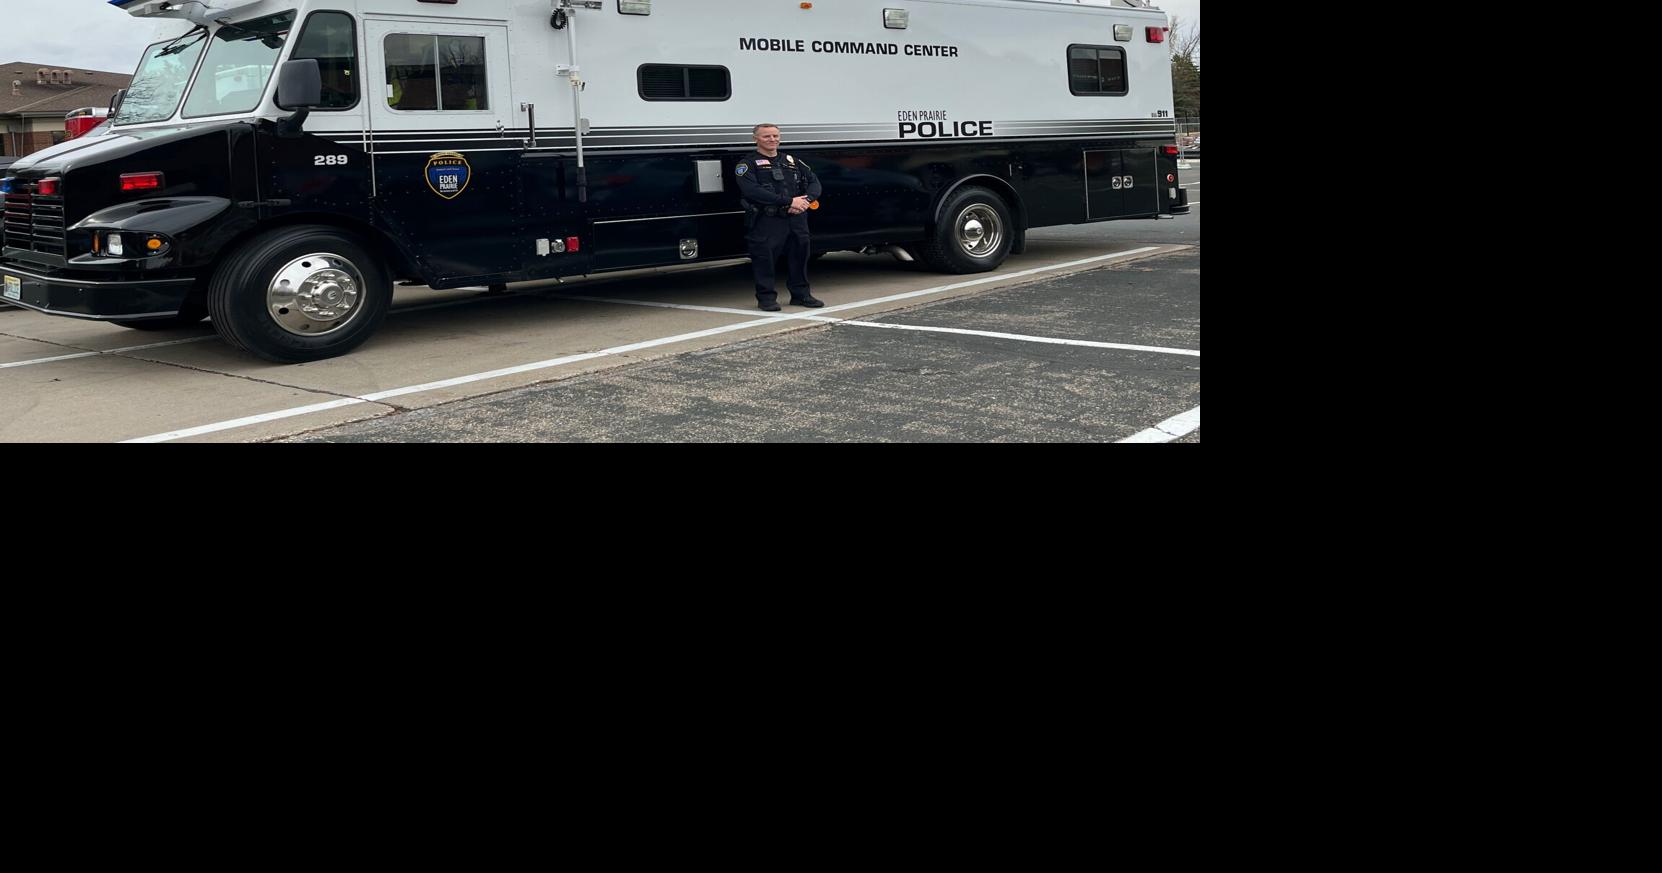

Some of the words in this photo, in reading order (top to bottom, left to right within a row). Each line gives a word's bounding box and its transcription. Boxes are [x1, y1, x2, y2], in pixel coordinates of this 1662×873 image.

[739, 37, 805, 52] MOBILE
[811, 40, 898, 55] COMMAND
[904, 44, 959, 57] CENTER
[897, 110, 918, 121] EDEN
[919, 110, 947, 121] PRAIRIE
[1157, 110, 1168, 118] 911
[898, 120, 993, 138] POLICE
[314, 154, 348, 166] 289
[439, 174, 458, 184] EDEN
